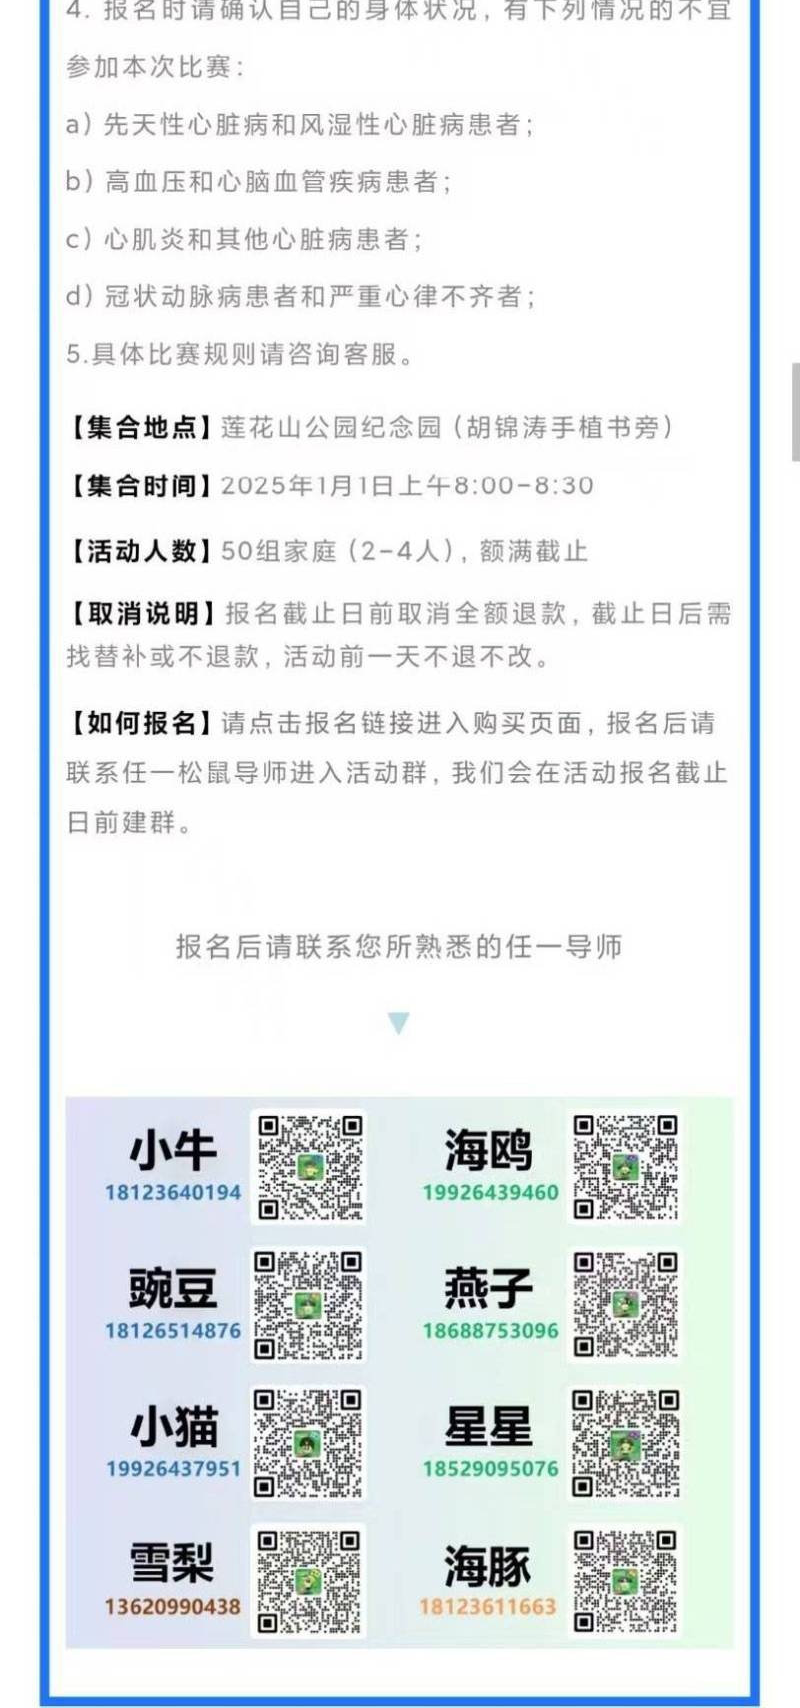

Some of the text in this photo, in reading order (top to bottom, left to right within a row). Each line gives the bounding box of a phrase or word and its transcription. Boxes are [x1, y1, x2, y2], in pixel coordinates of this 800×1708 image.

[67, 54, 243, 79] 参加本次比赛：
[68, 810, 190, 835] 日前建群。
[176, 934, 622, 961] 报名后请联系您所熟悉的任一导师
[130, 1128, 217, 1171] 小牛
[445, 1128, 532, 1171] 海鸥
[106, 1184, 242, 1201] 18123640194
[423, 1184, 559, 1201] 19926439460
[129, 1266, 218, 1309] 豌豆
[445, 1266, 533, 1310] 燕子
[106, 1322, 241, 1339] 18126514876
[423, 1322, 559, 1339] 18688753096
[131, 1405, 219, 1448] 小猫
[445, 1405, 533, 1447] 星星
[107, 1460, 241, 1477] 19926437951
[423, 1460, 559, 1477] 18529095076
[130, 1541, 215, 1584] 雪梨
[444, 1545, 531, 1588] 海豚
[105, 1598, 241, 1615] 13620990438
[420, 1598, 557, 1615] 18123611663
